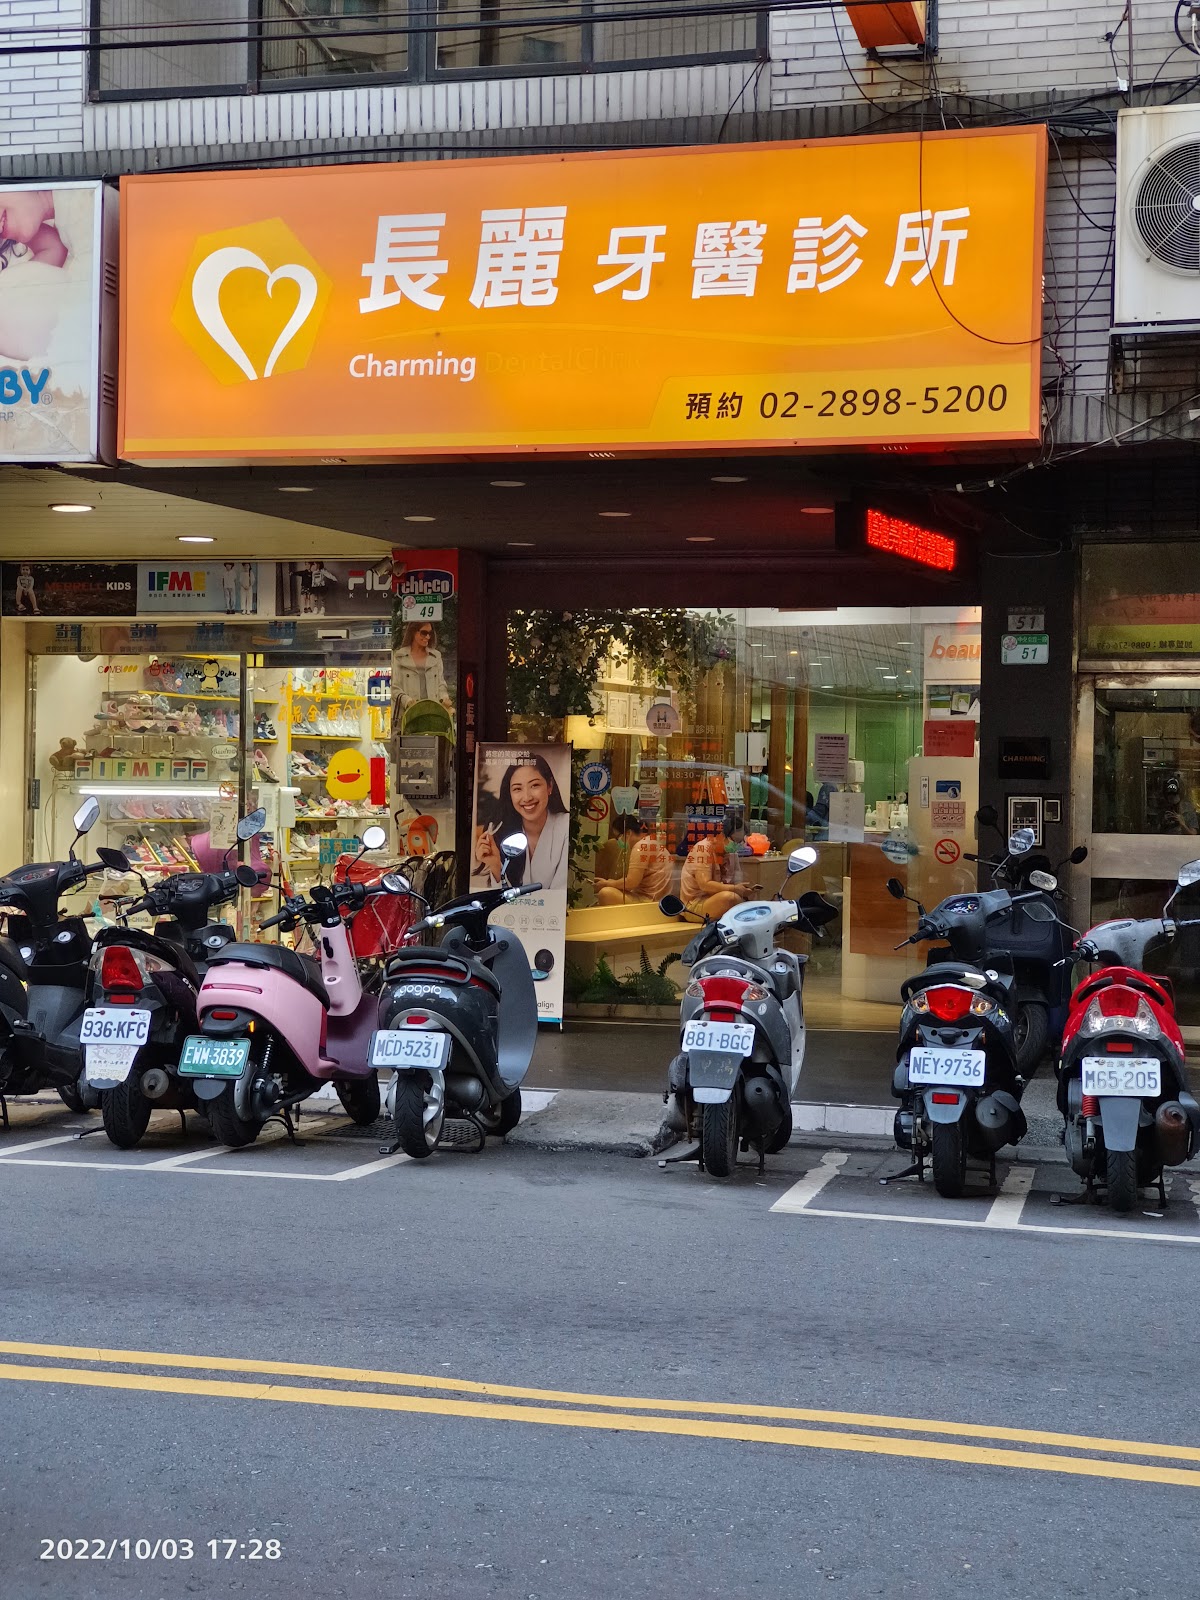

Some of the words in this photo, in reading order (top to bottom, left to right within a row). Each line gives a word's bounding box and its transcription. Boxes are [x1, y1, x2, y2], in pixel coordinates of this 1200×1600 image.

[359, 206, 970, 314] 長麗牙醫診所
[350, 352, 476, 382] Charming
[686, 391, 743, 419] 預約
[761, 384, 1007, 419] 02-2898-5200
[106, 582, 132, 591] KIDS
[148, 571, 207, 591] IFME
[401, 573, 450, 595] chicco
[420, 606, 435, 618] 49
[1016, 615, 1036, 630] 51
[929, 635, 981, 659] beau
[1022, 647, 1037, 660] 51
[1002, 755, 1047, 763] CHARMING
[686, 805, 725, 815] 診療項目
[320, 840, 357, 853] 營業中
[400, 985, 442, 996] gogoro
